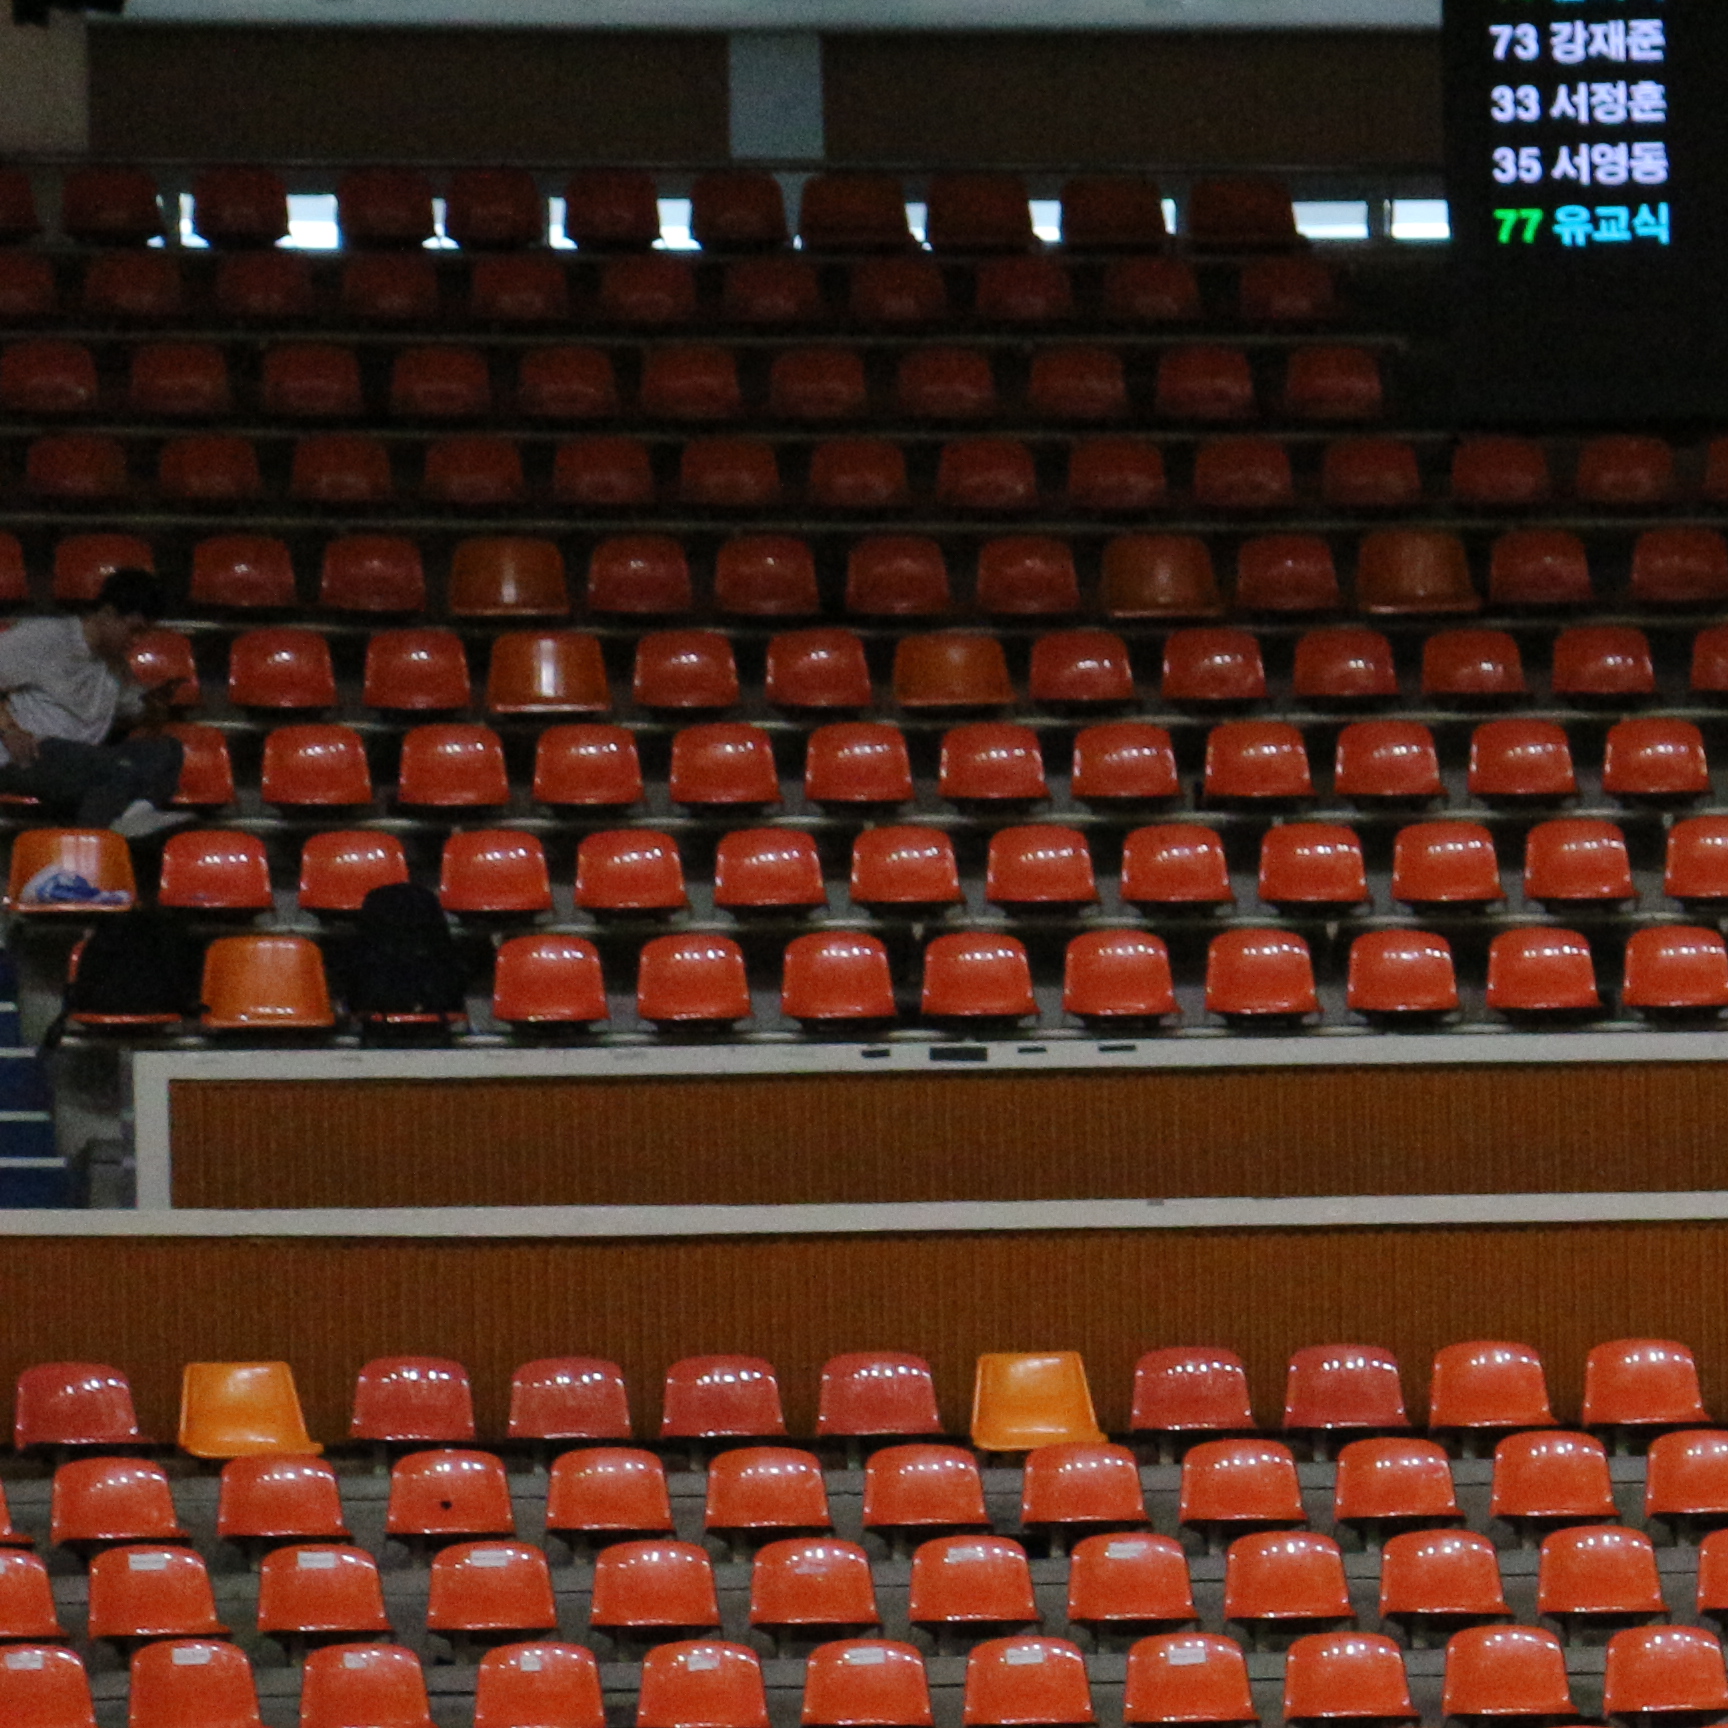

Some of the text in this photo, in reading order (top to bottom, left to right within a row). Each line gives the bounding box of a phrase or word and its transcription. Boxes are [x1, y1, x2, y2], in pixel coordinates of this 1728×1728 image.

[1489, 19, 1666, 64] 73 강재준
[1491, 80, 1667, 125] 33 서정훈
[1492, 142, 1669, 186] 35 서영동
[1493, 202, 1670, 247] 77 유교식
